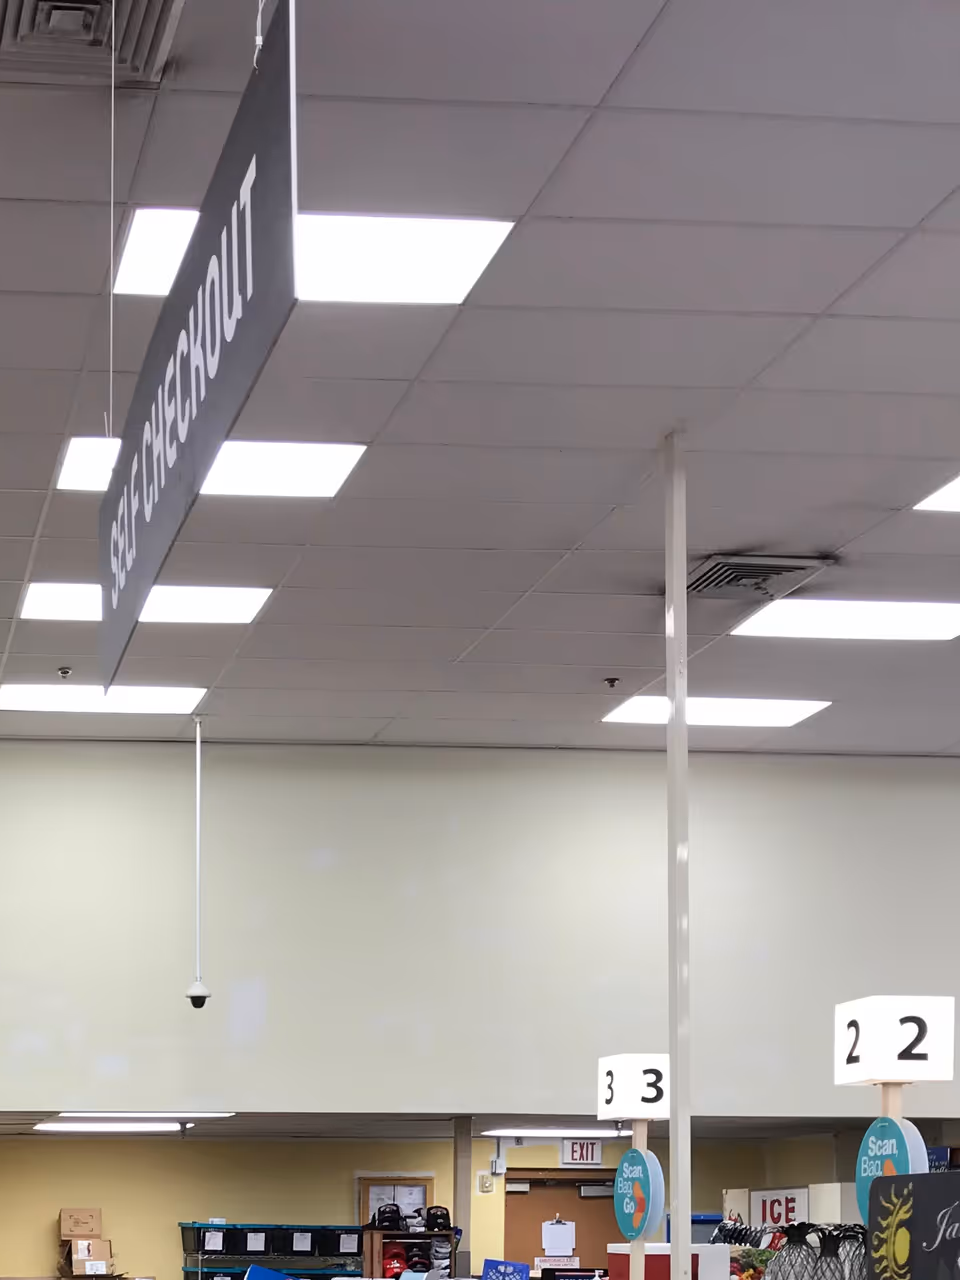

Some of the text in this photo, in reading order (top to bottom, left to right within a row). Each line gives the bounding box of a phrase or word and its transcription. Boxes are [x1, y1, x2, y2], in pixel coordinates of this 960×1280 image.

[111, 153, 257, 609] SELF CHECKOUT
[846, 1019, 860, 1065] 2
[897, 1015, 928, 1061] 2
[605, 1070, 614, 1105] 3
[641, 1068, 664, 1103] 3
[571, 1142, 596, 1161] EXIT
[868, 1136, 898, 1157] Scan,
[624, 1197, 635, 1213] Go
[762, 1197, 796, 1224] ICE
[922, 1201, 960, 1252] Ja
